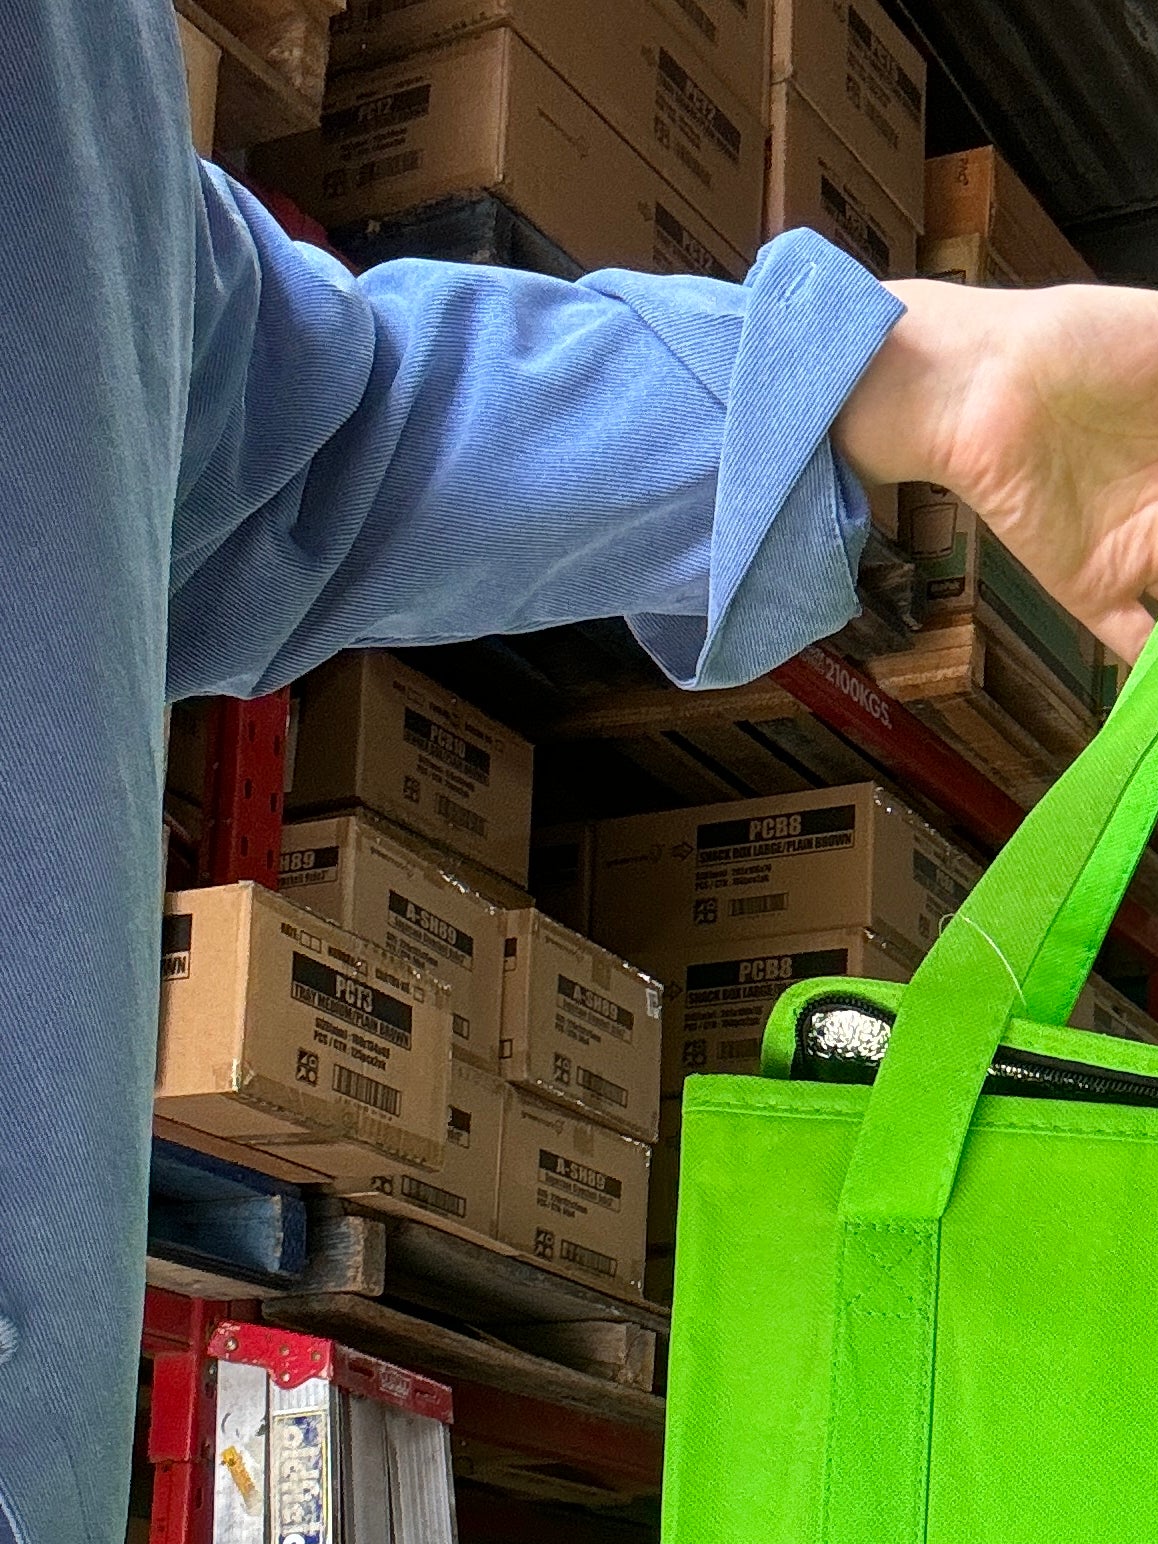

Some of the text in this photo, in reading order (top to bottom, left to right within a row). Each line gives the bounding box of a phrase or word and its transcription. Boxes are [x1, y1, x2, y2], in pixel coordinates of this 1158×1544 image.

[748, 815, 802, 841] PCB8
[407, 903, 457, 945] A-SH89
[739, 957, 793, 983] PCB8
[294, 983, 316, 1005] TRAY
[335, 973, 373, 1013] PCT3
[573, 984, 618, 1021] A-SH89
[556, 1157, 606, 1190] A-SH89
